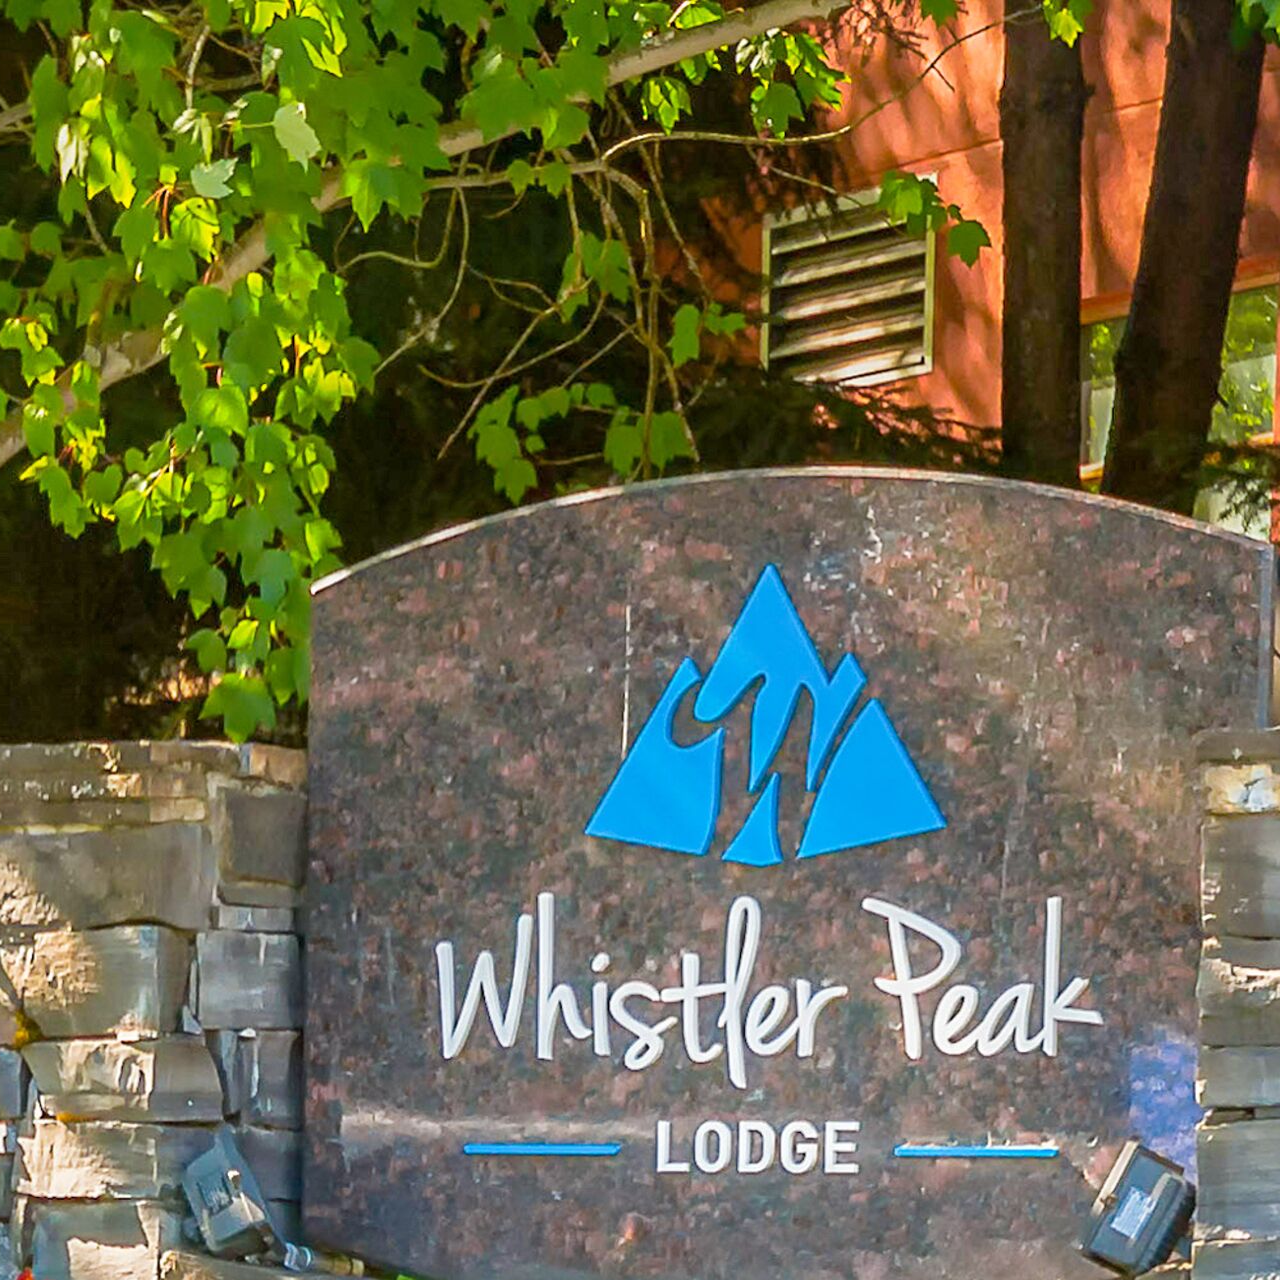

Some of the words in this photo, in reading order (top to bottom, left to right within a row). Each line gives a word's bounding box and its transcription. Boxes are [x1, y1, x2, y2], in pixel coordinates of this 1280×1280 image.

[435, 891, 849, 1090] Whistler
[861, 895, 1105, 1061] Peak
[655, 1119, 861, 1175] LODGE
